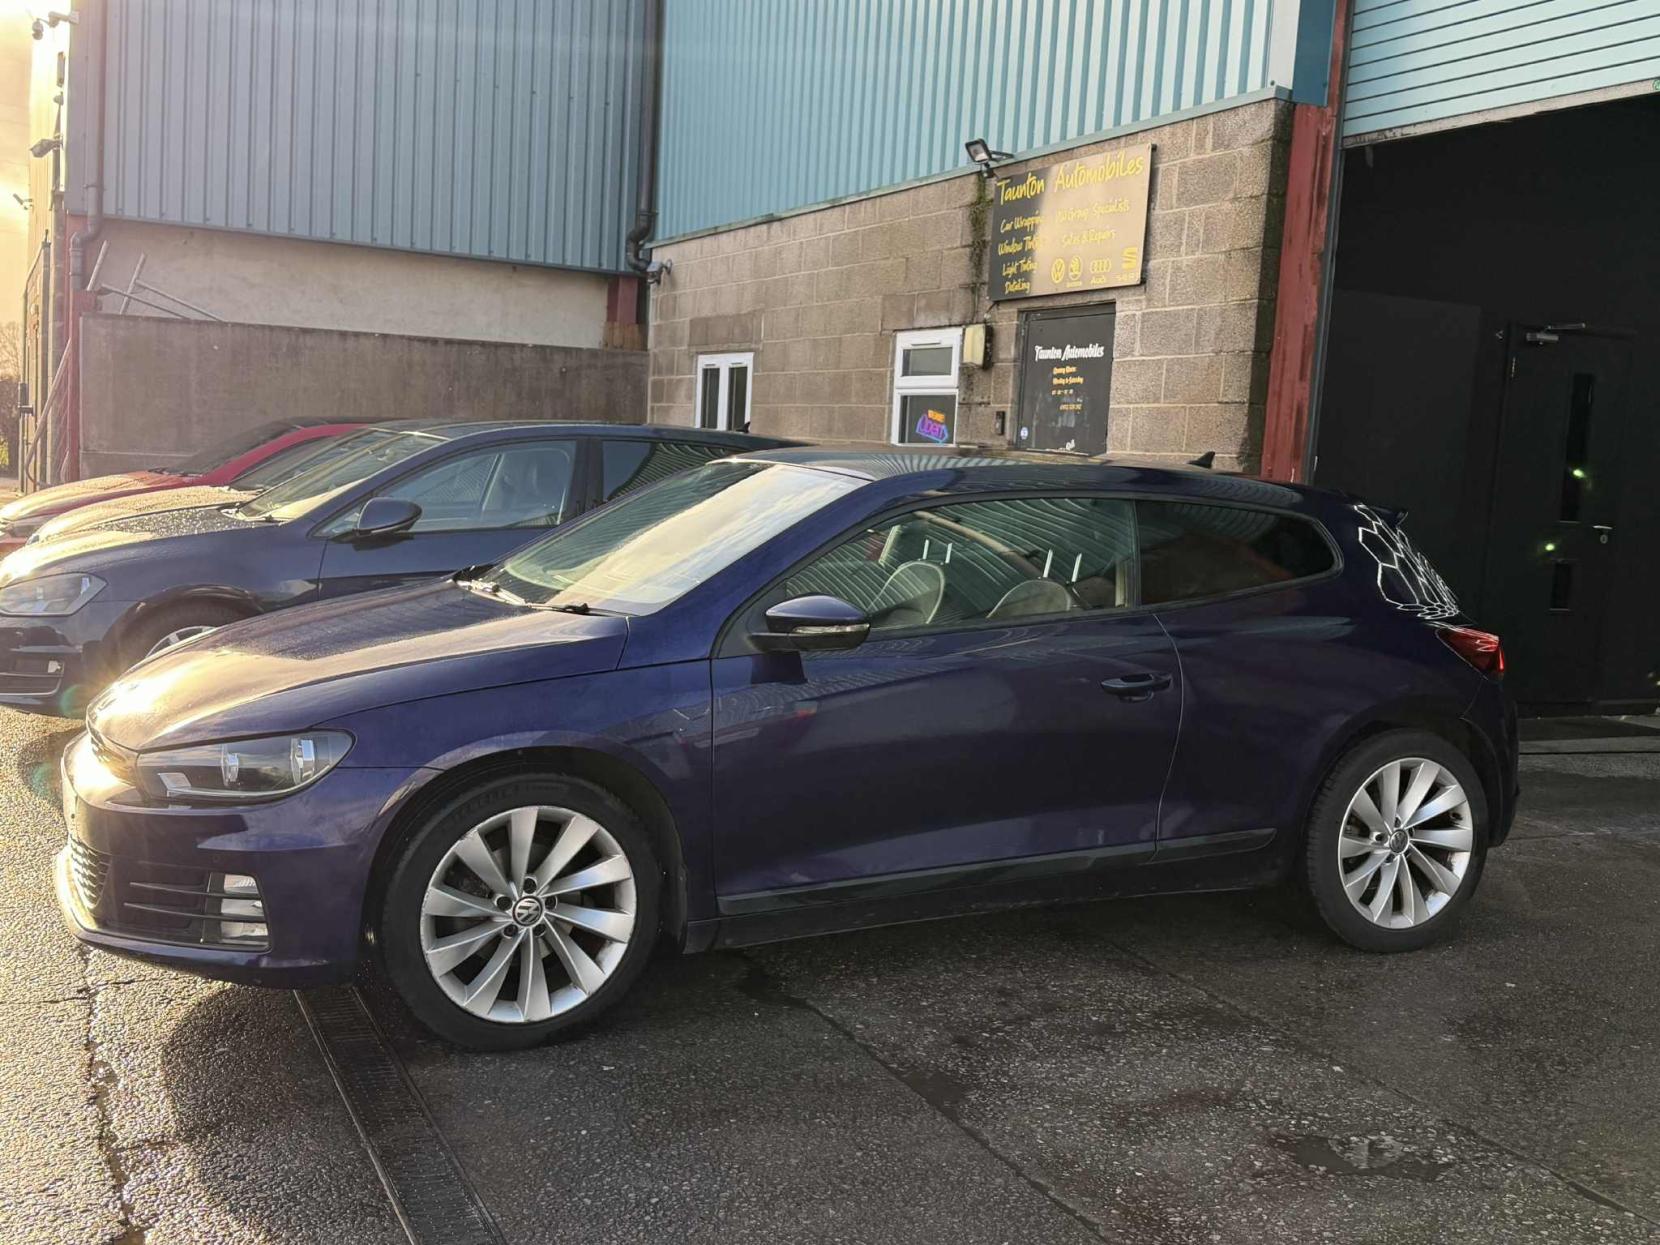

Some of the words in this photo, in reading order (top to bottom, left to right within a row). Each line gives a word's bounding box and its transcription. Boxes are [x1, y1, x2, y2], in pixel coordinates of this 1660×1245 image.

[997, 172, 1045, 205] Taunton
[1000, 218, 1013, 233] Car
[998, 238, 1022, 255] Window
[1034, 345, 1062, 362] Taunton
[1061, 343, 1105, 361] Automobiles
